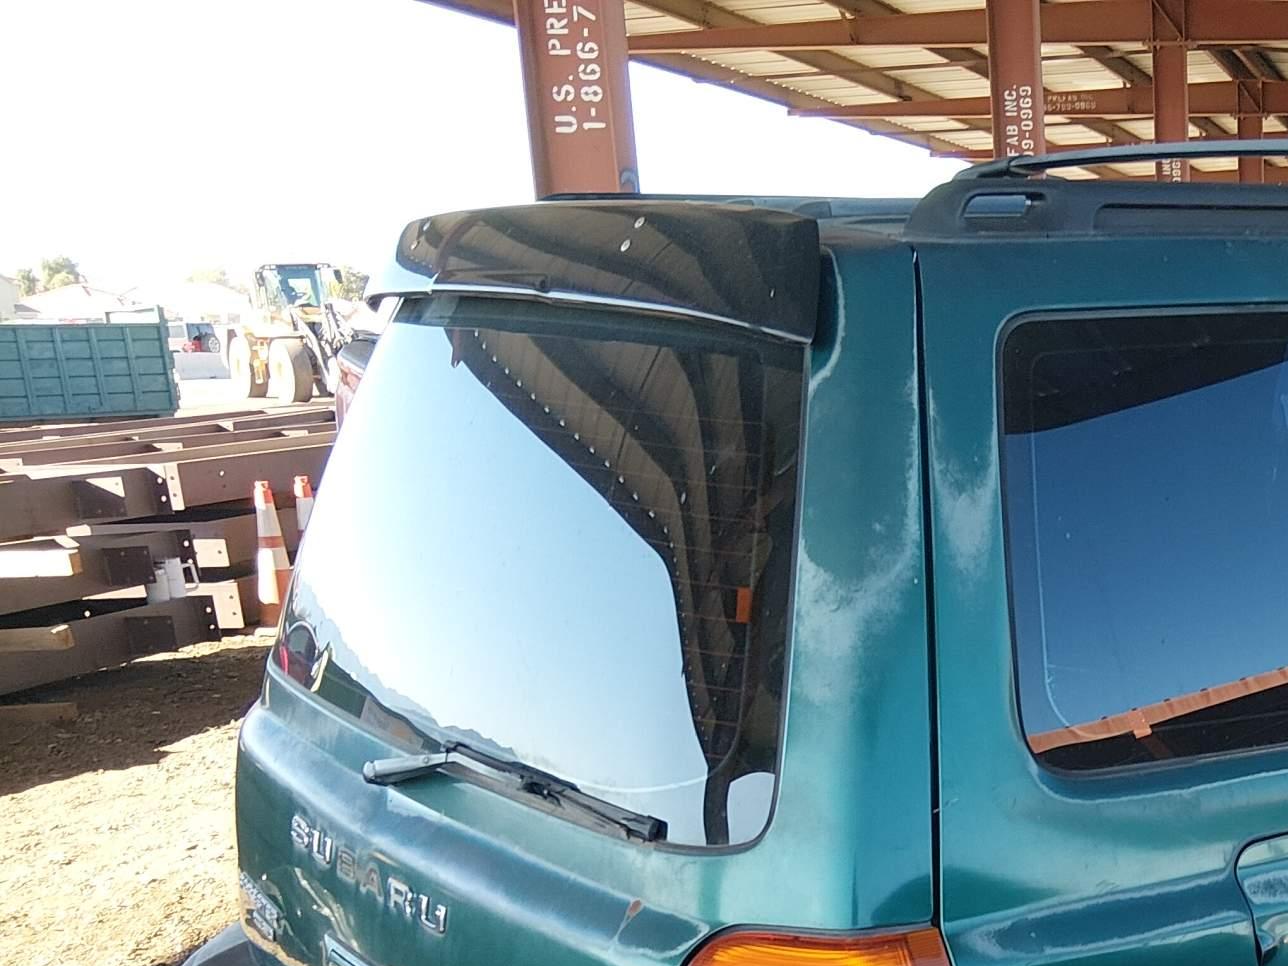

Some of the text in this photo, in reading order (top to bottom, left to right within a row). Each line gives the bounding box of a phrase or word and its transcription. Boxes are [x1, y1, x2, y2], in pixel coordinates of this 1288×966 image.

[552, 75, 578, 134] U.S.
[573, 5, 606, 130] 1-866-7
[1003, 84, 1018, 117] INC.
[290, 814, 449, 936] SUBARU
